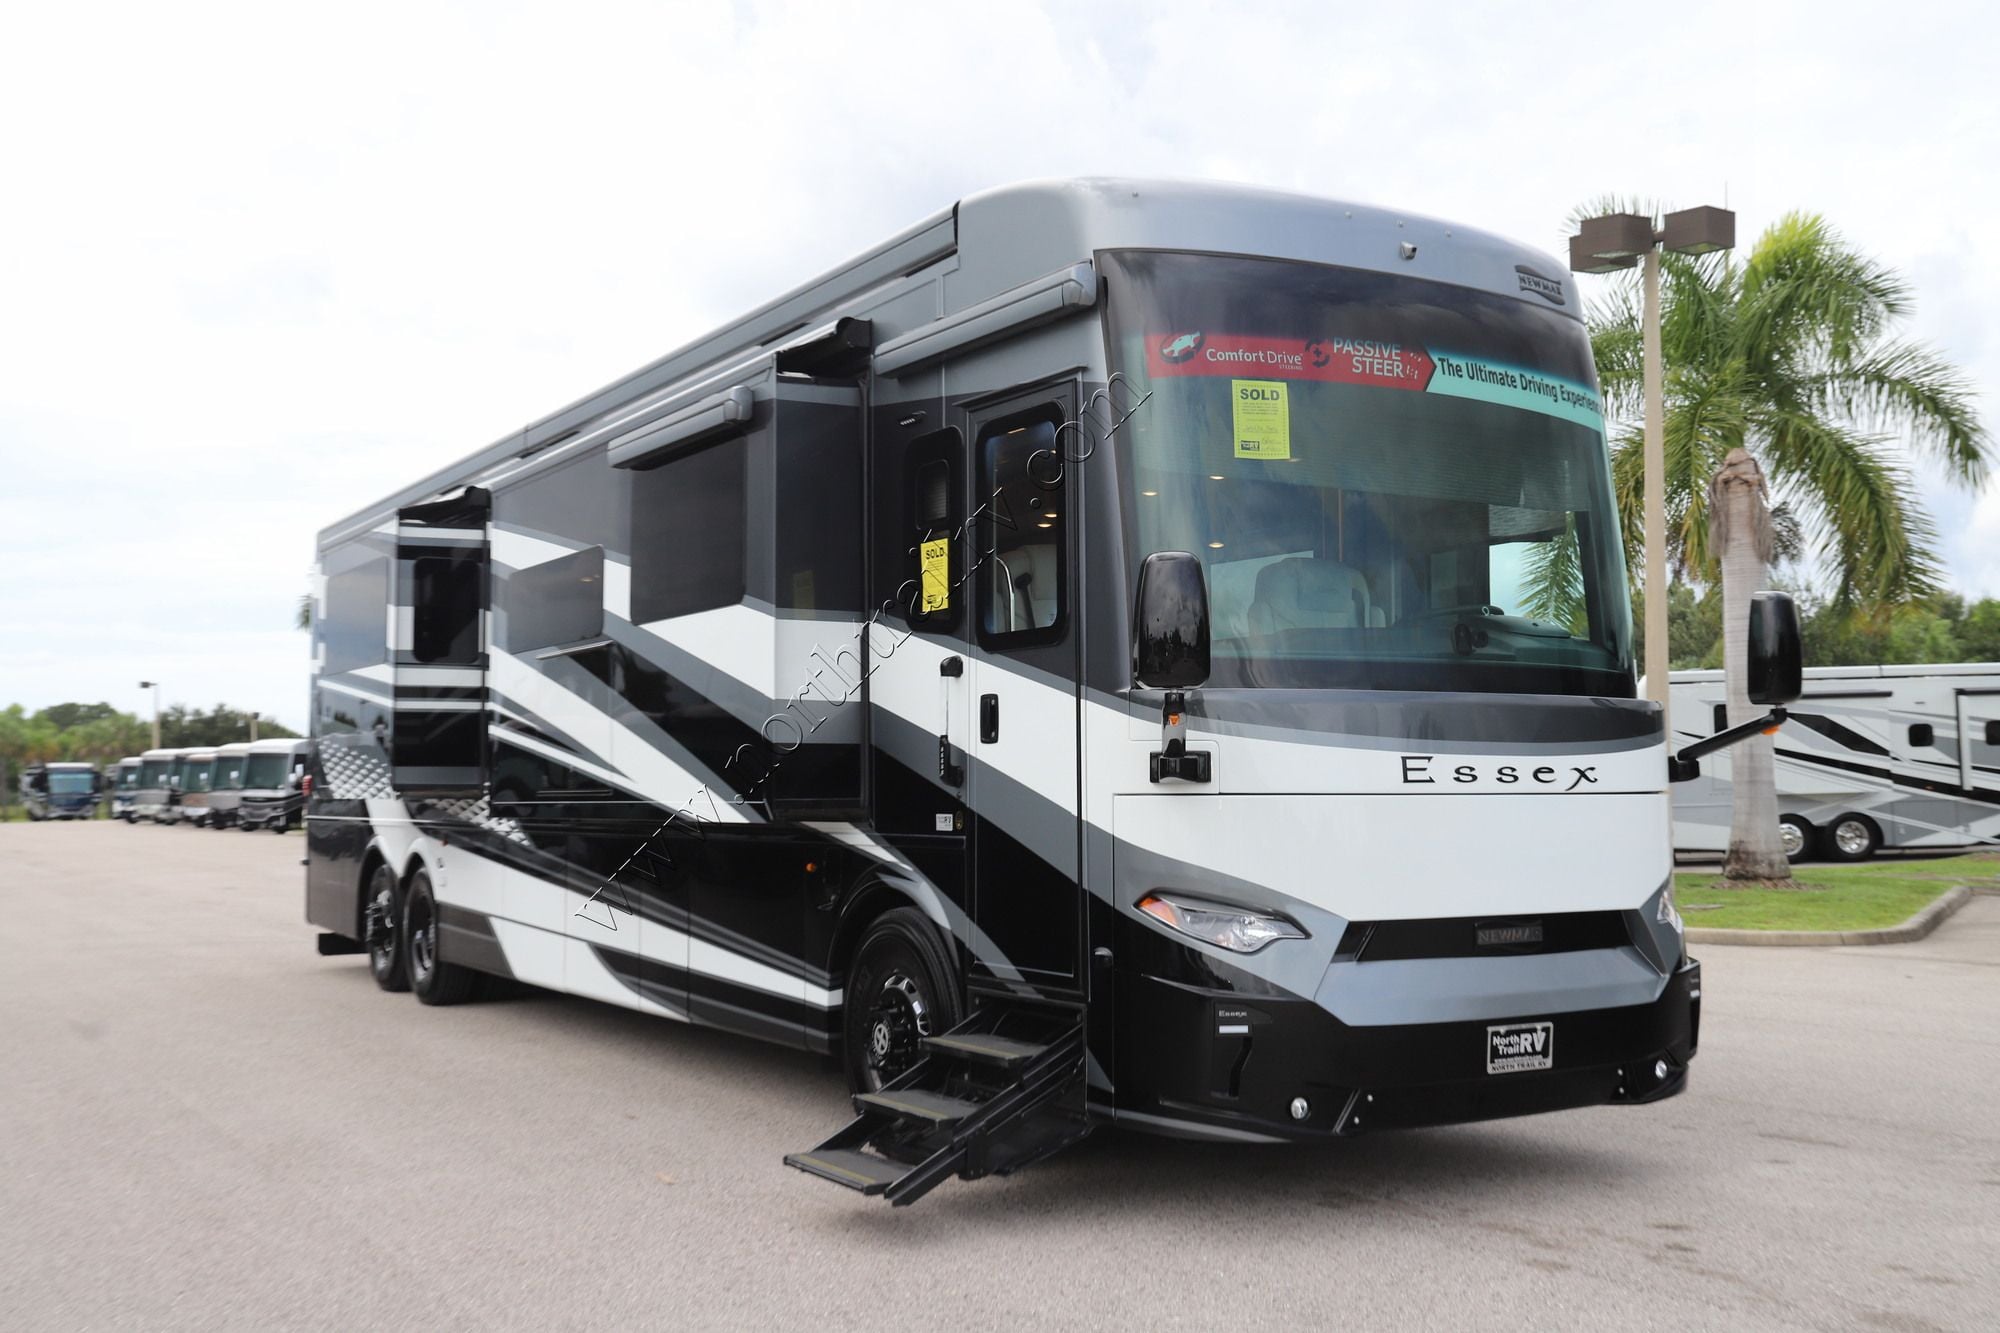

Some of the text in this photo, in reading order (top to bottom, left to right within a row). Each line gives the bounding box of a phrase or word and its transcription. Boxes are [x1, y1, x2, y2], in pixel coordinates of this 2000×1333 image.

[1206, 348, 1302, 365] Comfort Drive
[1333, 337, 1402, 361] PASSIVE
[1352, 356, 1405, 378] STEER
[1438, 356, 1463, 379] The
[1465, 361, 1518, 389] Ultimate
[1519, 373, 1558, 403] Driving
[1240, 388, 1280, 401] SOLD
[925, 546, 945, 560] SOLD
[1401, 755, 1598, 792] Essex
[1492, 1034, 1520, 1047] North
[1497, 1043, 1520, 1056] Trail
[1520, 1031, 1547, 1054] RV
